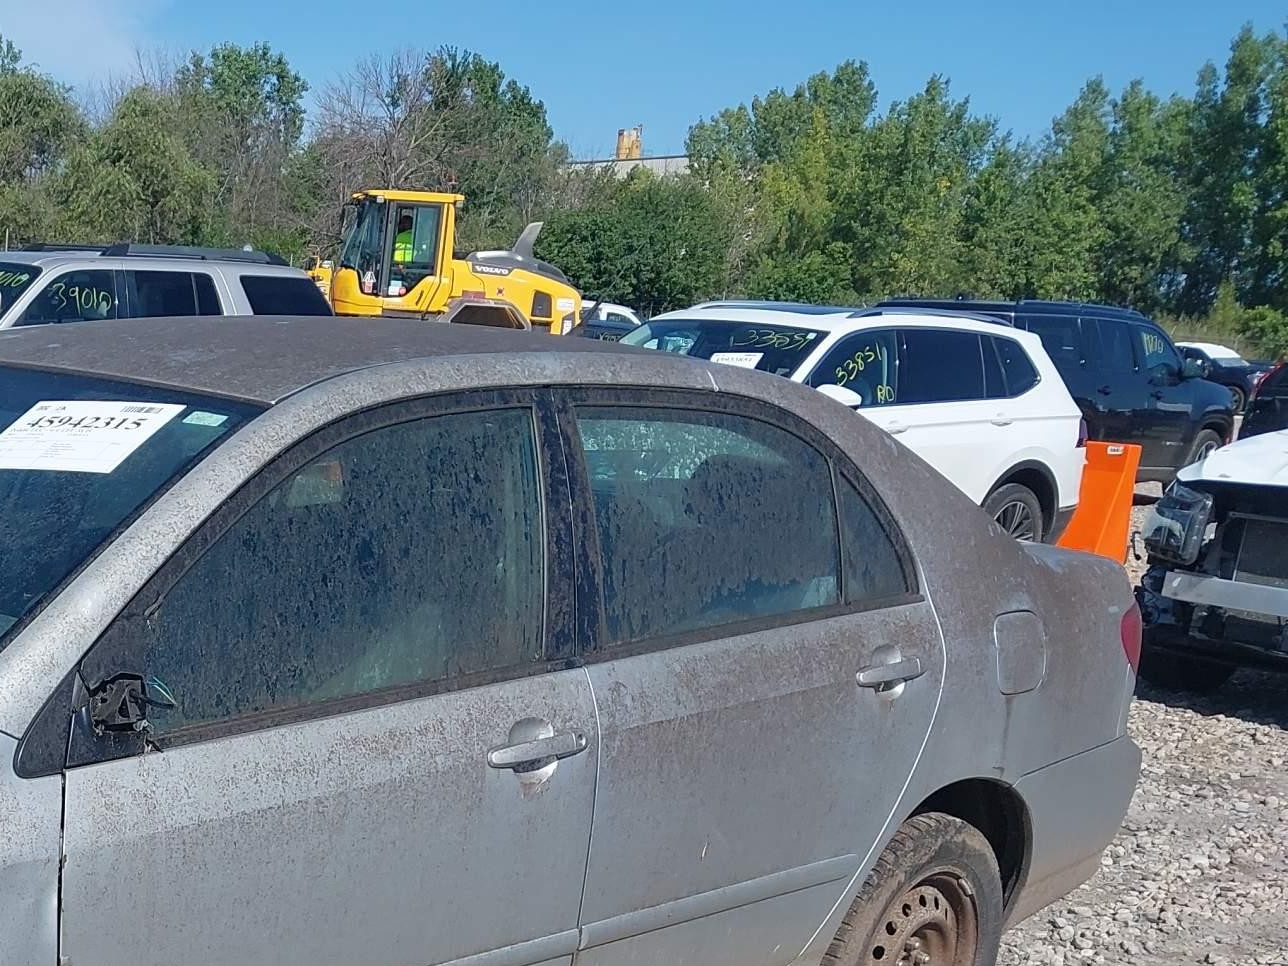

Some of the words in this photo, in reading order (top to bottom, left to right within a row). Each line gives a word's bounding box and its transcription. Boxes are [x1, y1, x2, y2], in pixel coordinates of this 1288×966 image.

[474, 265, 509, 275] VOLVO
[835, 342, 882, 386] 33851
[26, 415, 149, 430] 45942315
